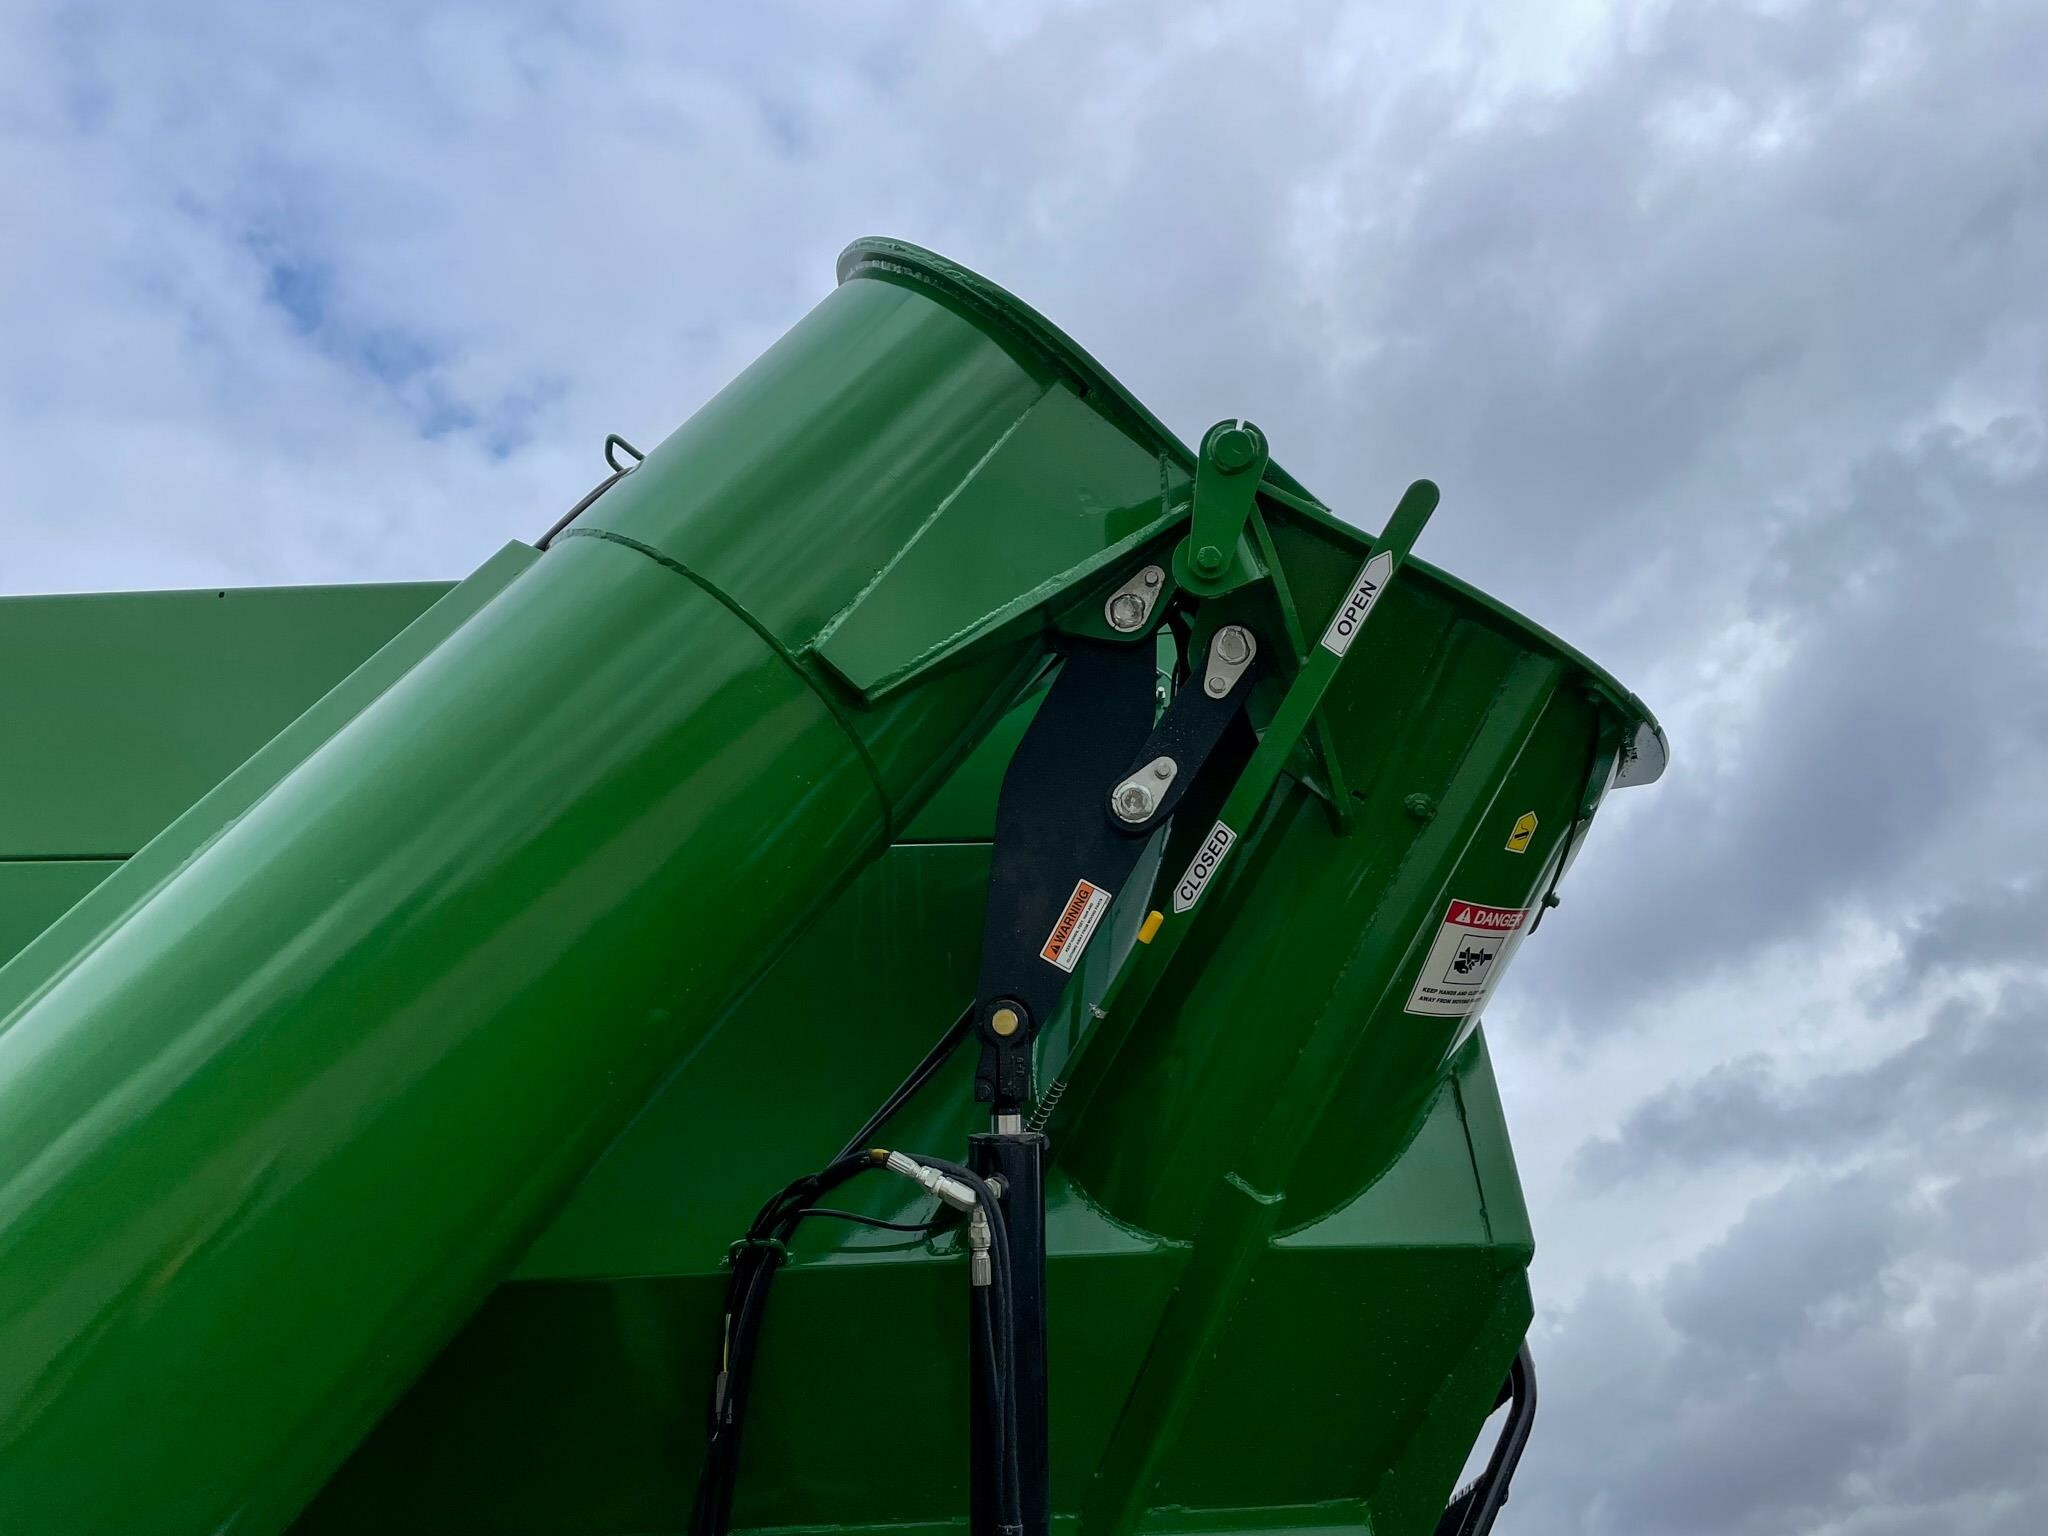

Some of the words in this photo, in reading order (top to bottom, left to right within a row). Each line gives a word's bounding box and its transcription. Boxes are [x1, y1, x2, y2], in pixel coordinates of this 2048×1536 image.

[1337, 580, 1378, 636] OPEN
[1180, 829, 1229, 901] CLOSED
[1055, 889, 1090, 943] WARNING
[1473, 910, 1524, 928] DANGER
